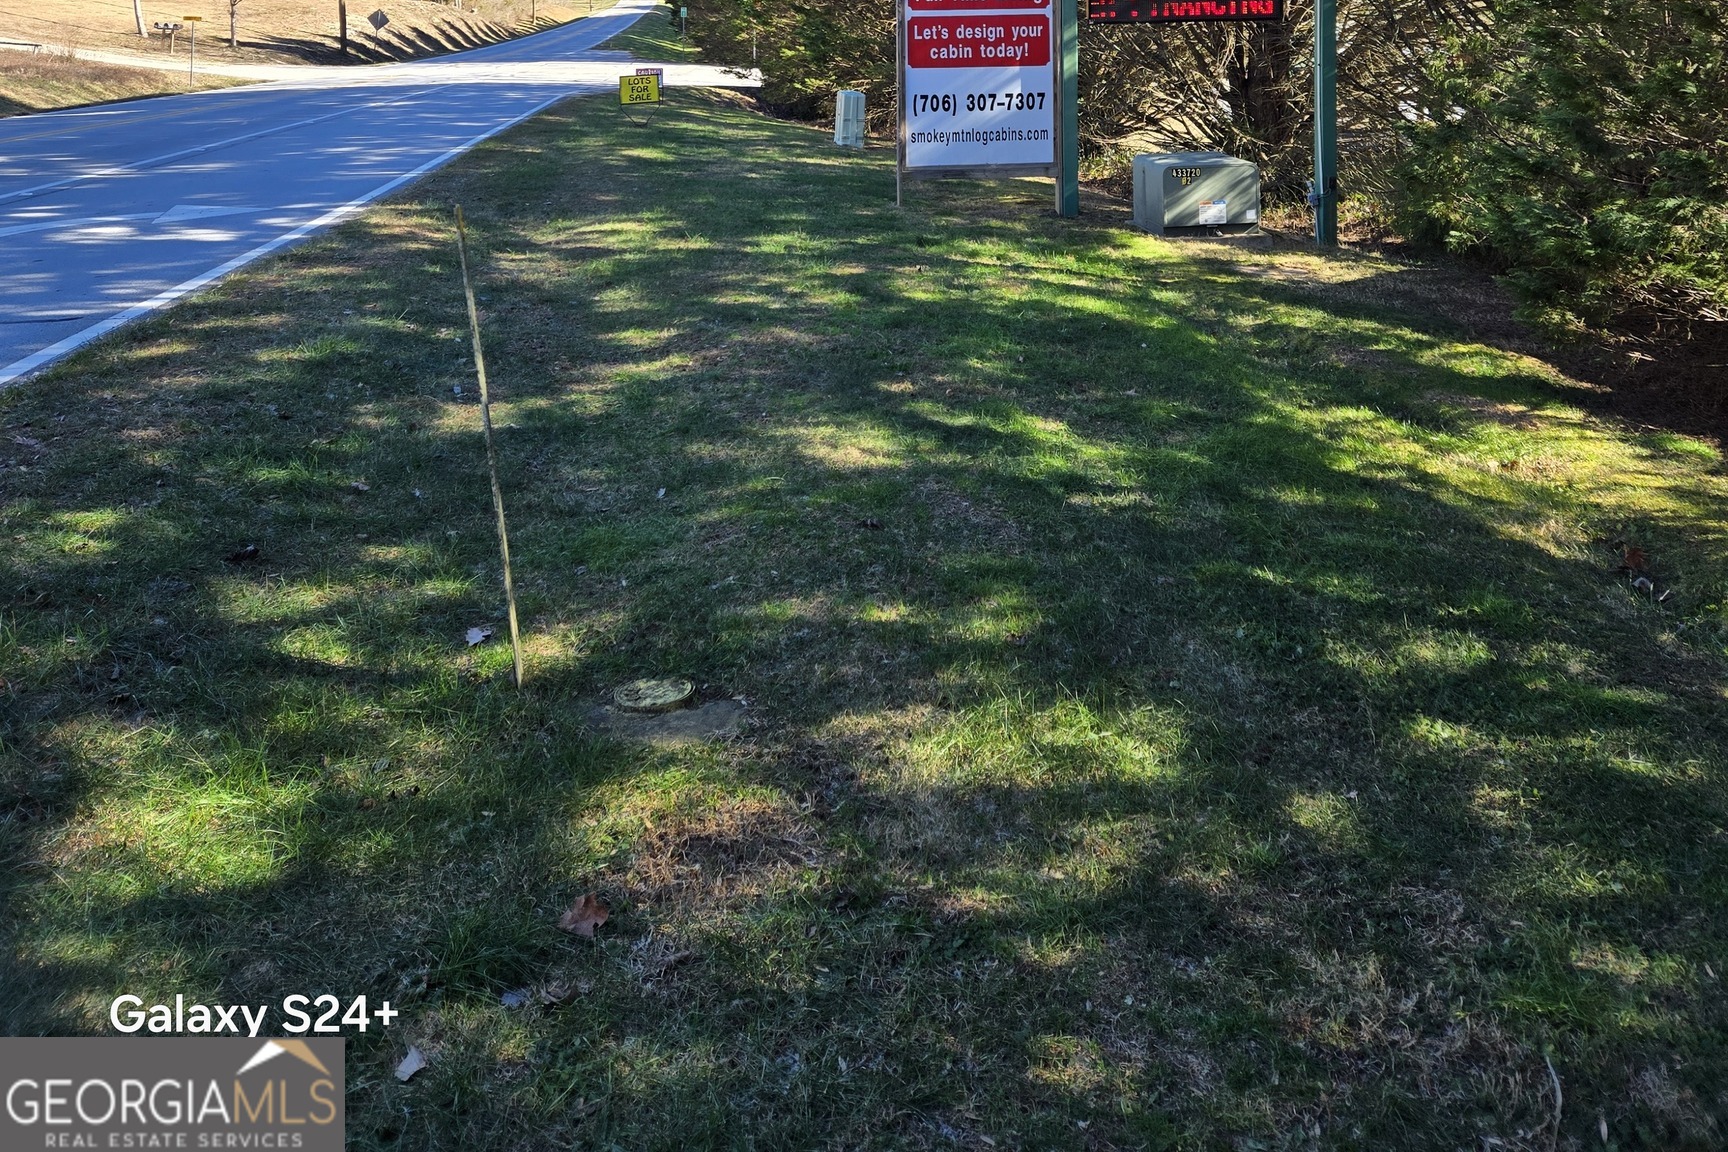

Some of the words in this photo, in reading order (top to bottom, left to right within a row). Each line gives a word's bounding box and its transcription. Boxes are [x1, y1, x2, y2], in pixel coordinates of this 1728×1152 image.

[914, 25, 949, 40] Let's
[956, 24, 1004, 41] design
[1011, 25, 1043, 41] your
[930, 44, 972, 59] cabin
[980, 42, 1029, 61] today!
[628, 77, 651, 85] LOTS
[629, 93, 652, 101] SALE
[913, 94, 957, 117] (706)
[966, 92, 1046, 111] 307-7307
[911, 127, 1049, 146] smokeymtnlogcabins.com
[1172, 168, 1201, 177] 433720
